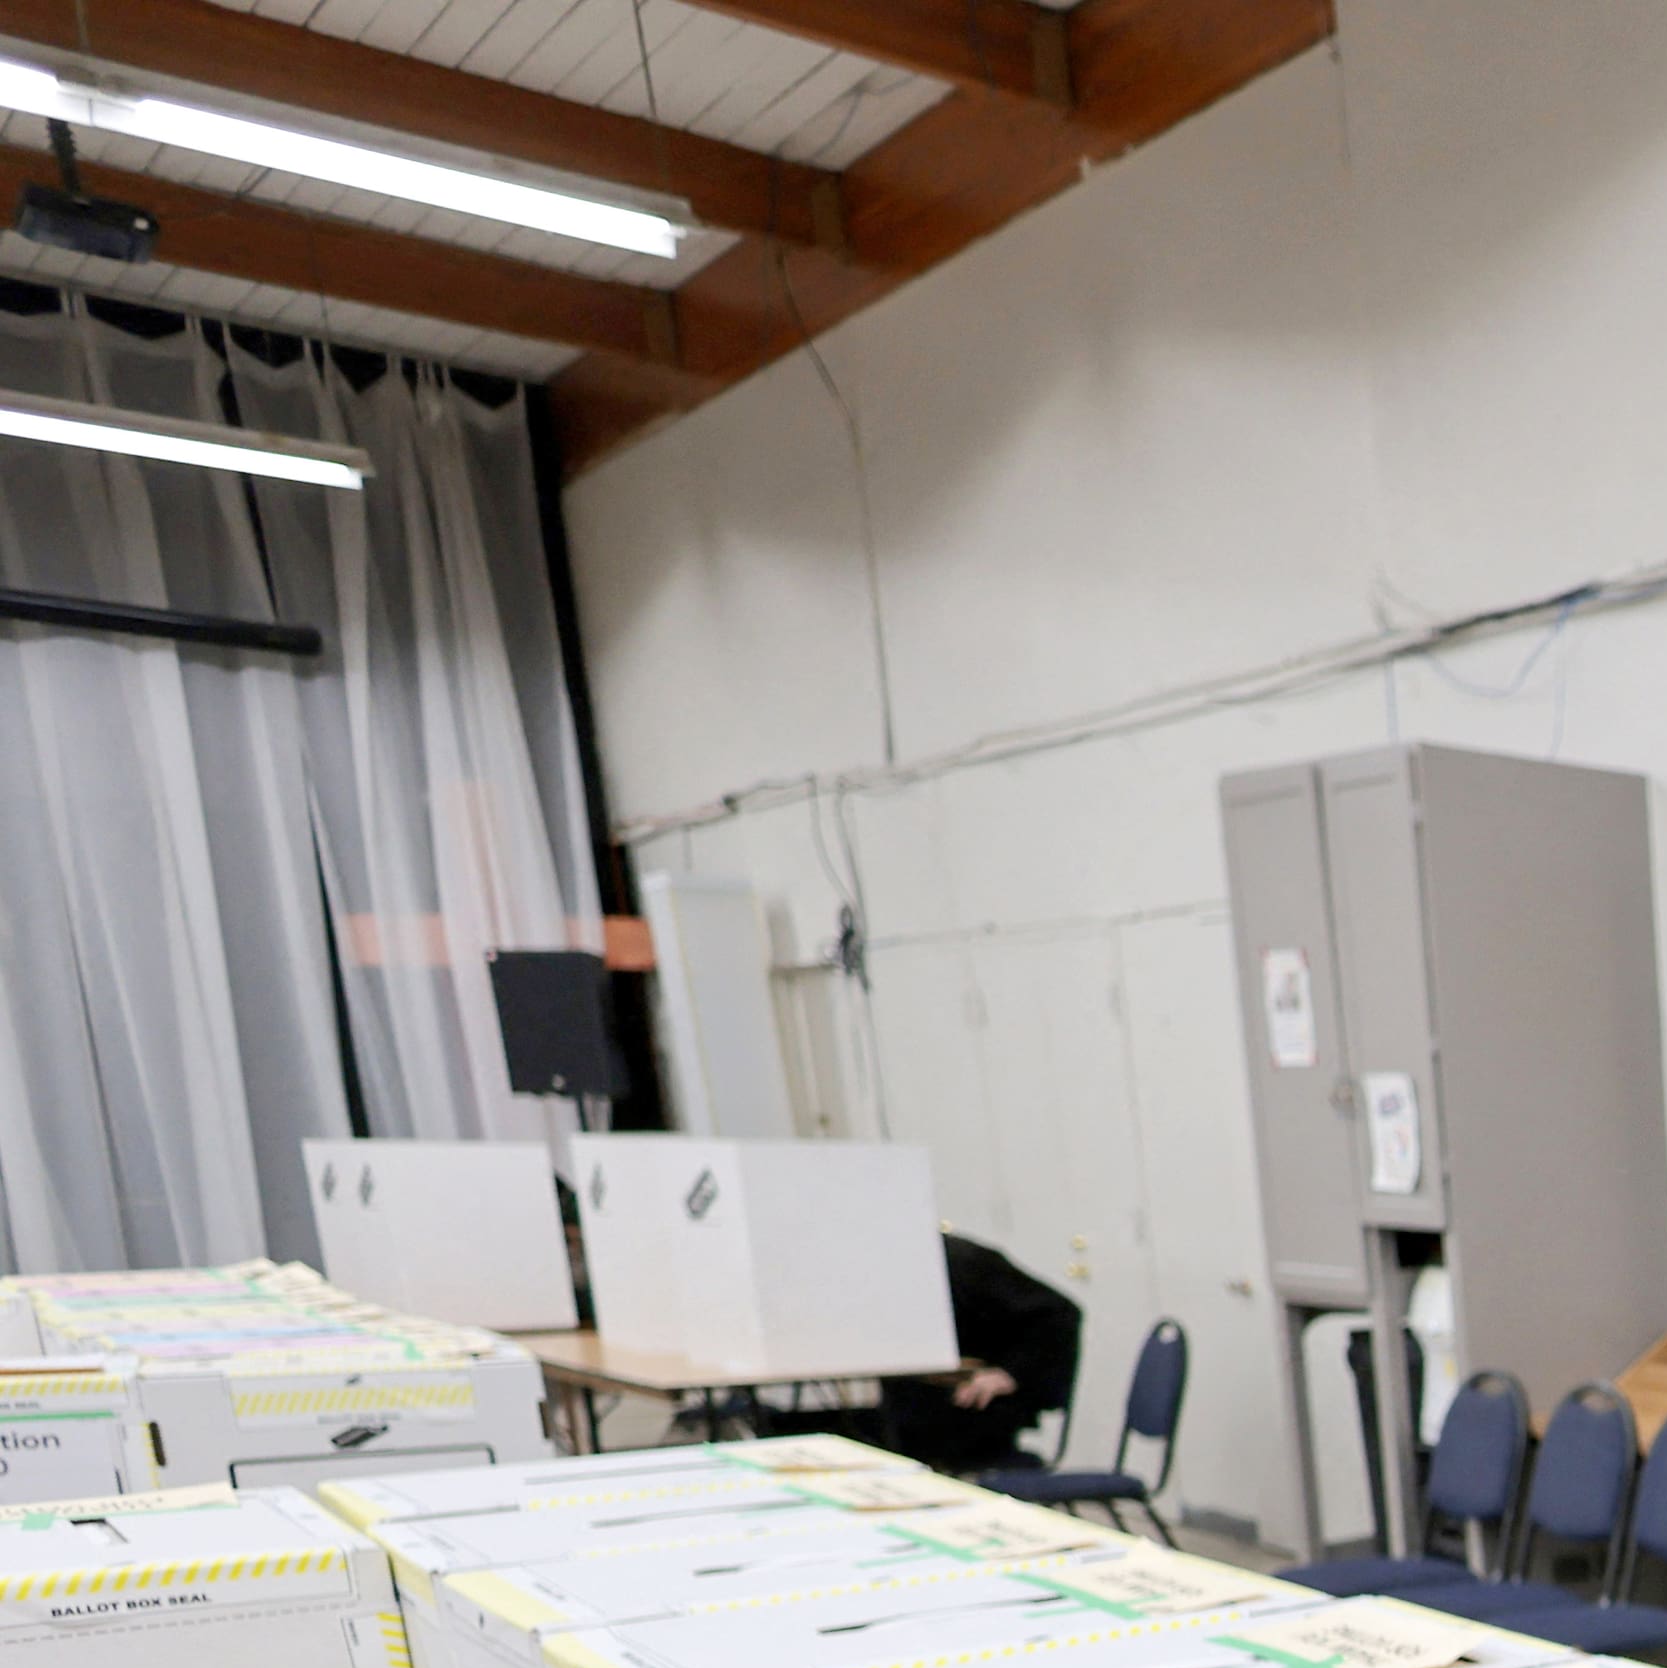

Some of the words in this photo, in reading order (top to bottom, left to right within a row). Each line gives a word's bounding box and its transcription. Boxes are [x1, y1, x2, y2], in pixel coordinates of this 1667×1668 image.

[51, 1602, 119, 1618] BALLOT
[127, 1597, 162, 1610] BOX
[169, 1593, 213, 1606] SEAL
